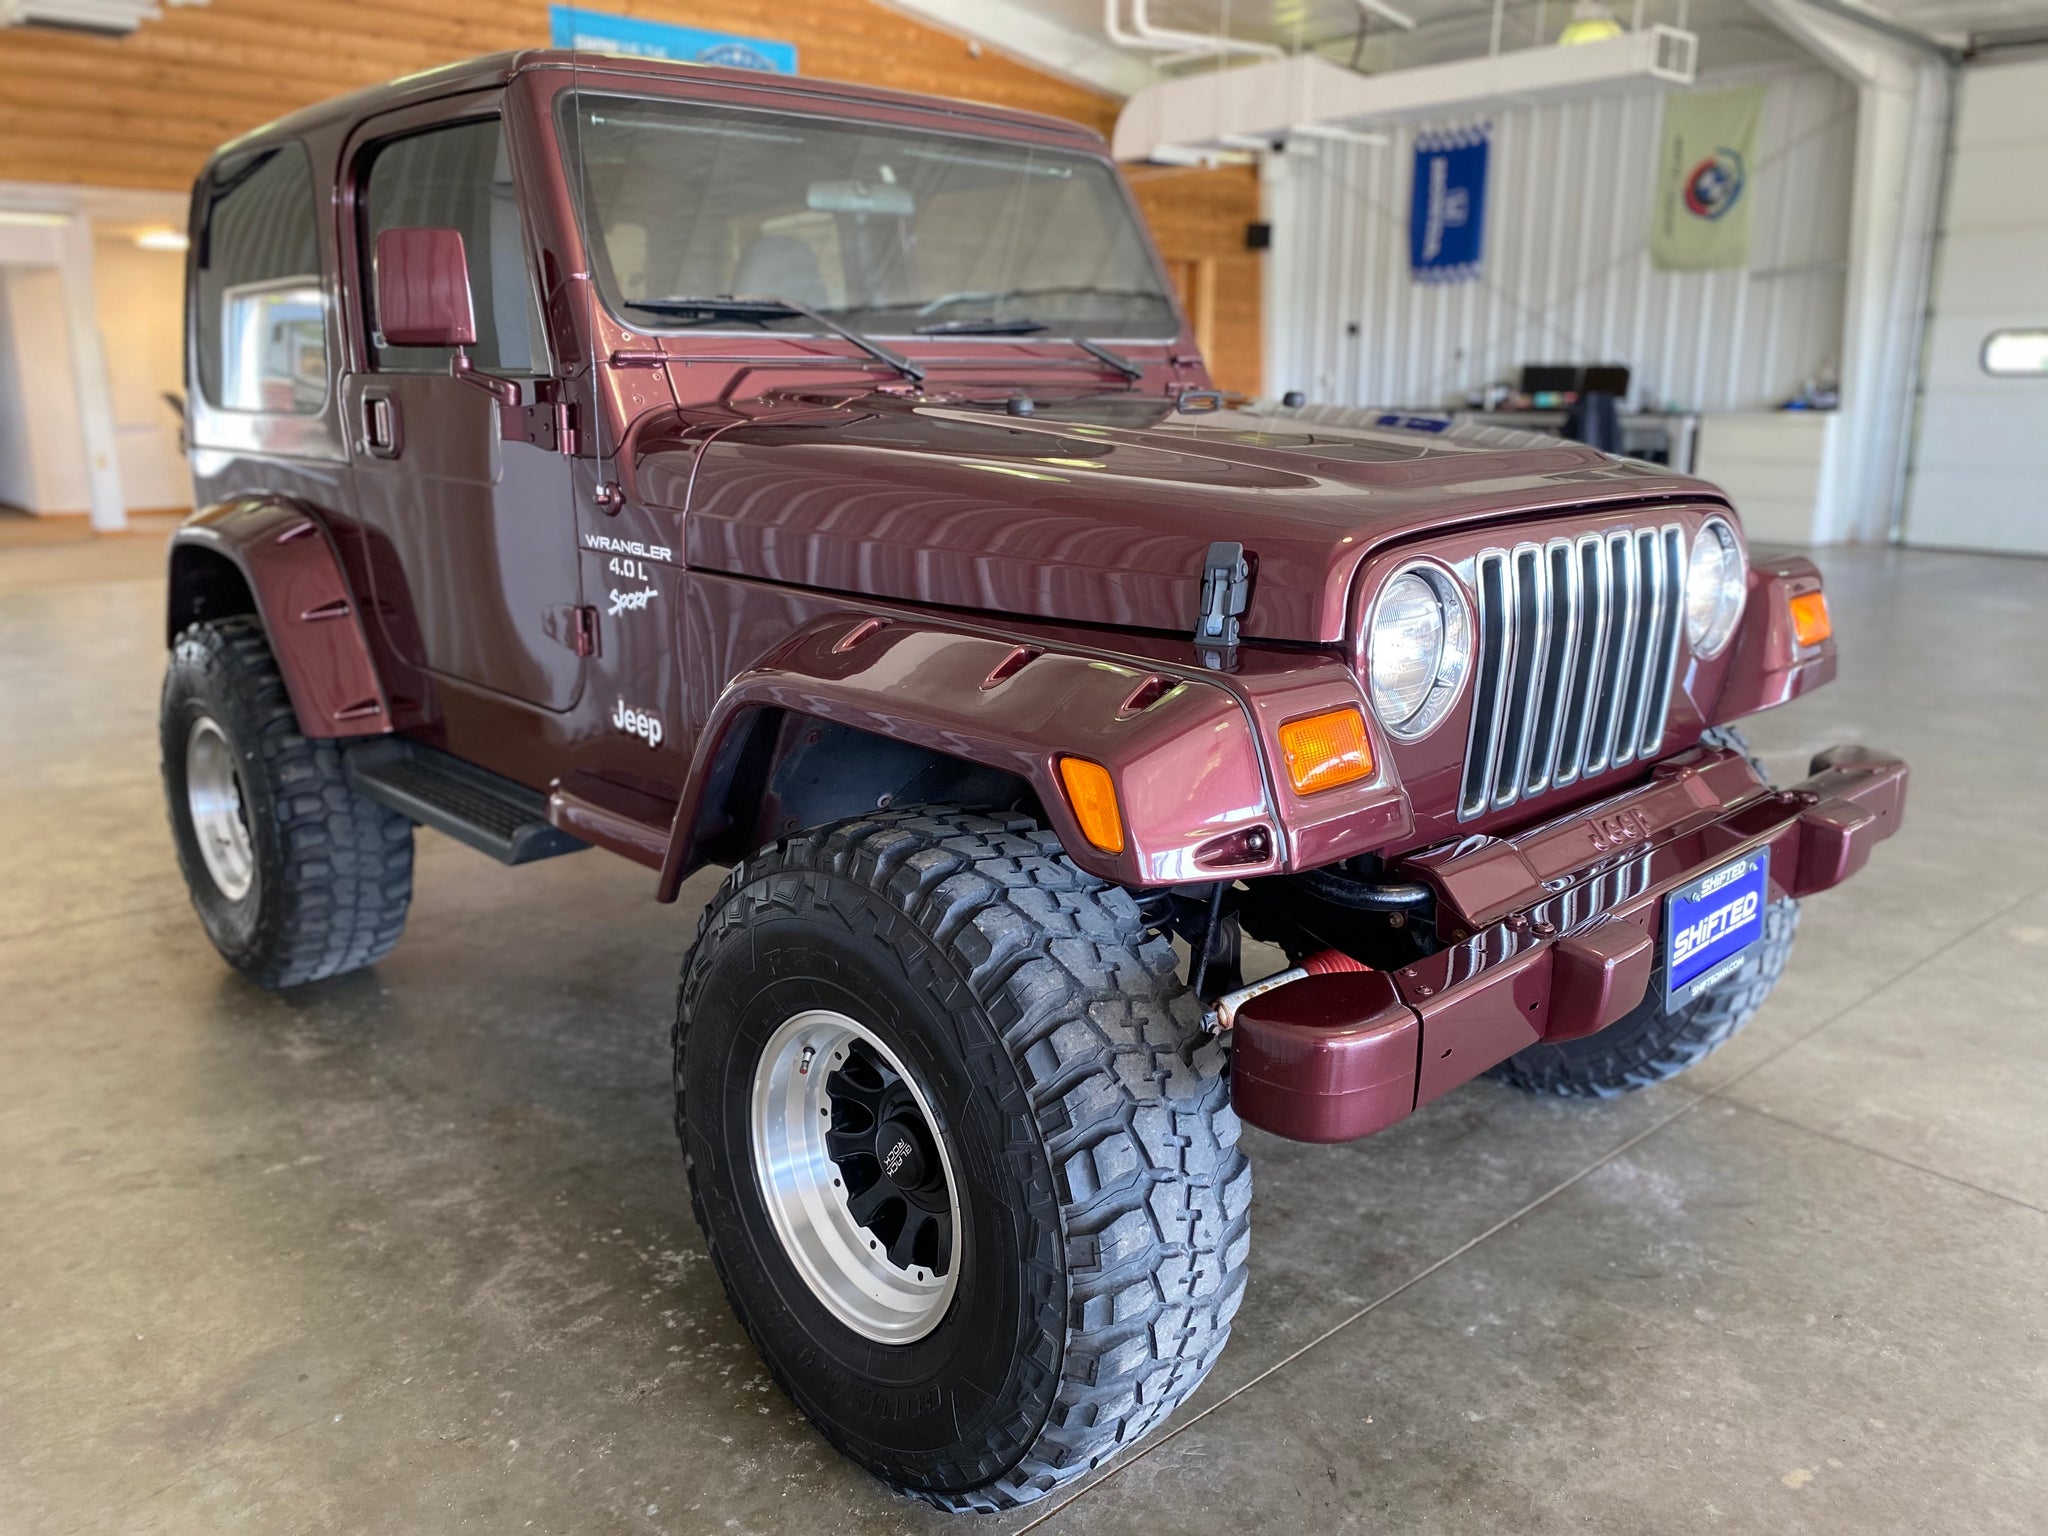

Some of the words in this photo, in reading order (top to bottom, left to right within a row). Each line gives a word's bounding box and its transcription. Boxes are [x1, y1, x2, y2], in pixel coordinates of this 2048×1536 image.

[585, 534, 672, 562] WRANGLER
[607, 585, 658, 618] Sport
[612, 699, 663, 747] Jeep
[1585, 808, 1652, 852] Jeep
[883, 1137, 905, 1166] ROCK
[886, 1143, 913, 1178] BLACK
